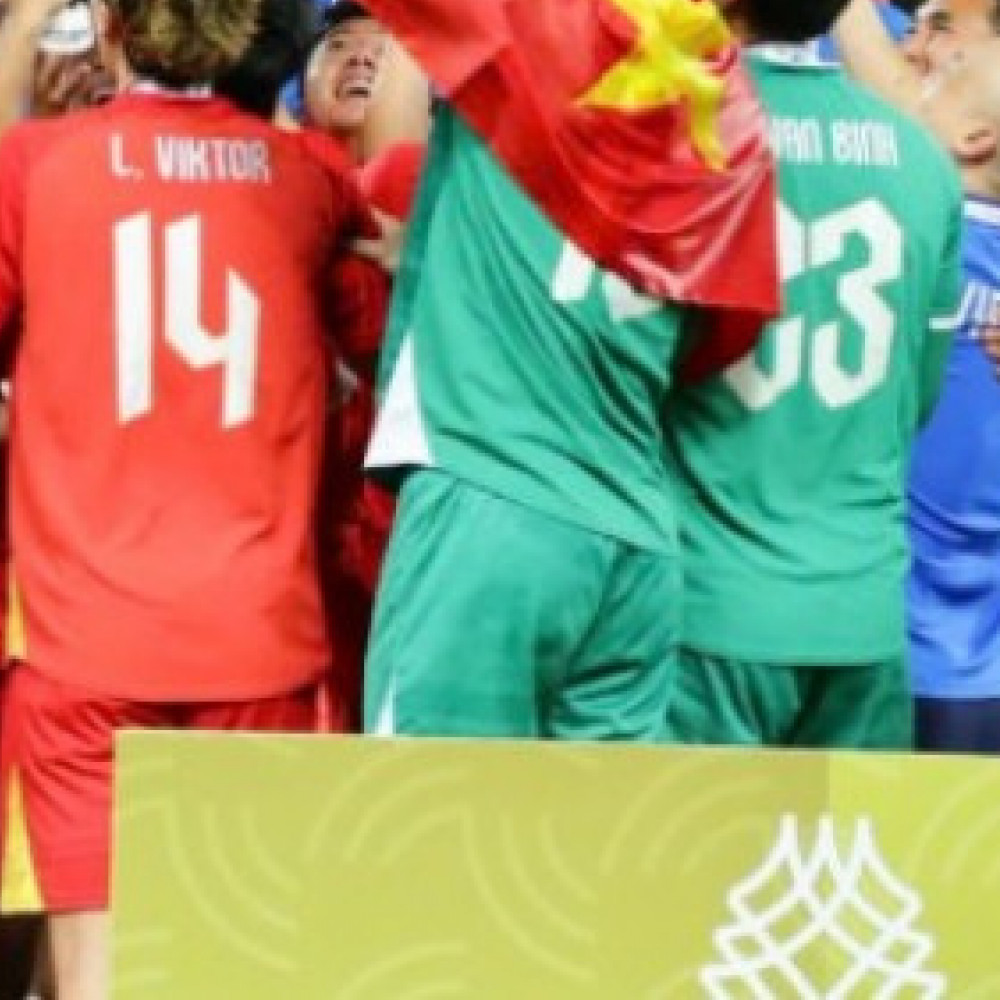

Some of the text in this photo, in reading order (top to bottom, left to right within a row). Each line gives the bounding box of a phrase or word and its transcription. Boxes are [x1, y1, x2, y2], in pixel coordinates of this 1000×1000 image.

[109, 132, 273, 184] L. VIKTOR
[832, 118, 898, 167] BINH
[112, 208, 262, 431] 14
